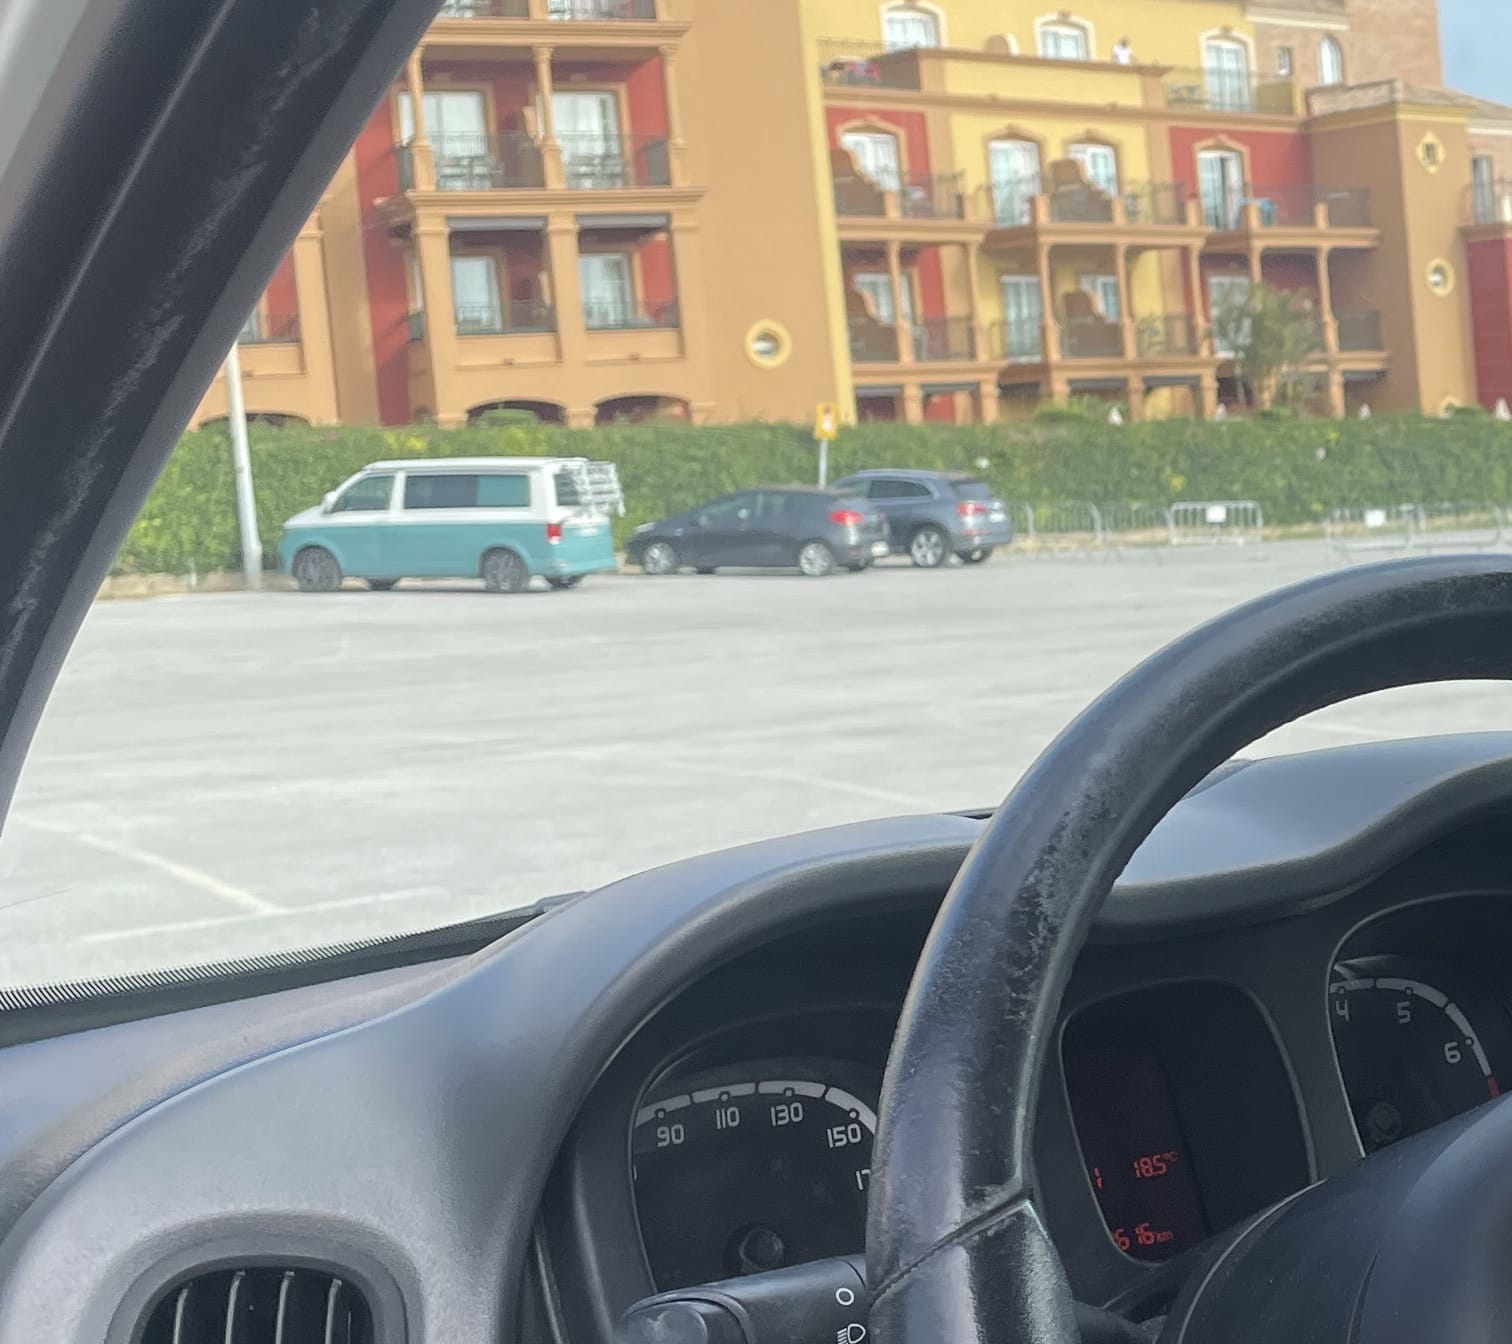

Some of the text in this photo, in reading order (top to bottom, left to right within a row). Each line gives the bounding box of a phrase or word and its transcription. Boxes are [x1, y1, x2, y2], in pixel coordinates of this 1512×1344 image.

[1397, 1001, 1411, 1024] 5
[1444, 1041, 1461, 1064] 6
[716, 1106, 740, 1130] 110
[770, 1102, 804, 1127] 130
[656, 1123, 685, 1148] 90
[826, 1123, 862, 1149] 150
